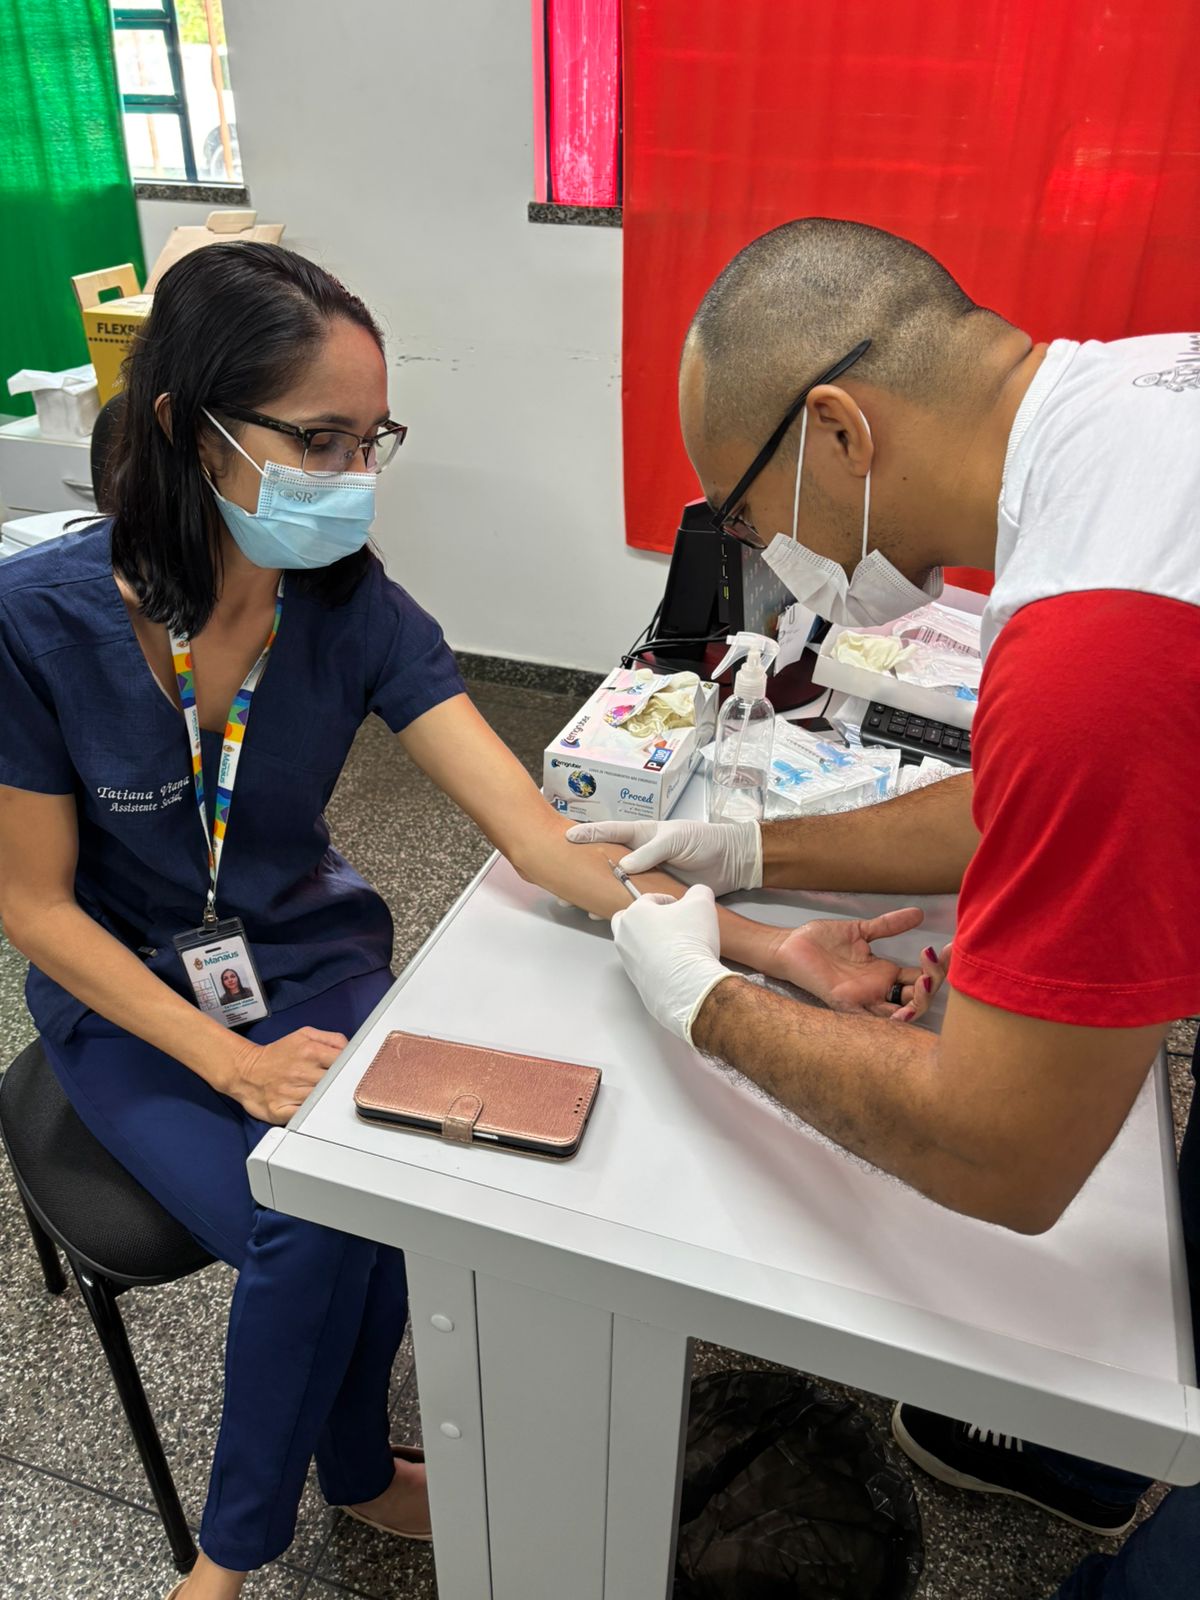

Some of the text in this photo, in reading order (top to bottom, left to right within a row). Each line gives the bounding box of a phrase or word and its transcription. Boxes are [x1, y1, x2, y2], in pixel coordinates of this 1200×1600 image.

[97, 786, 154, 801] Tatiana
[620, 787, 654, 804] Proced
[110, 802, 158, 813] Assistente
[203, 951, 239, 966] Manaus
